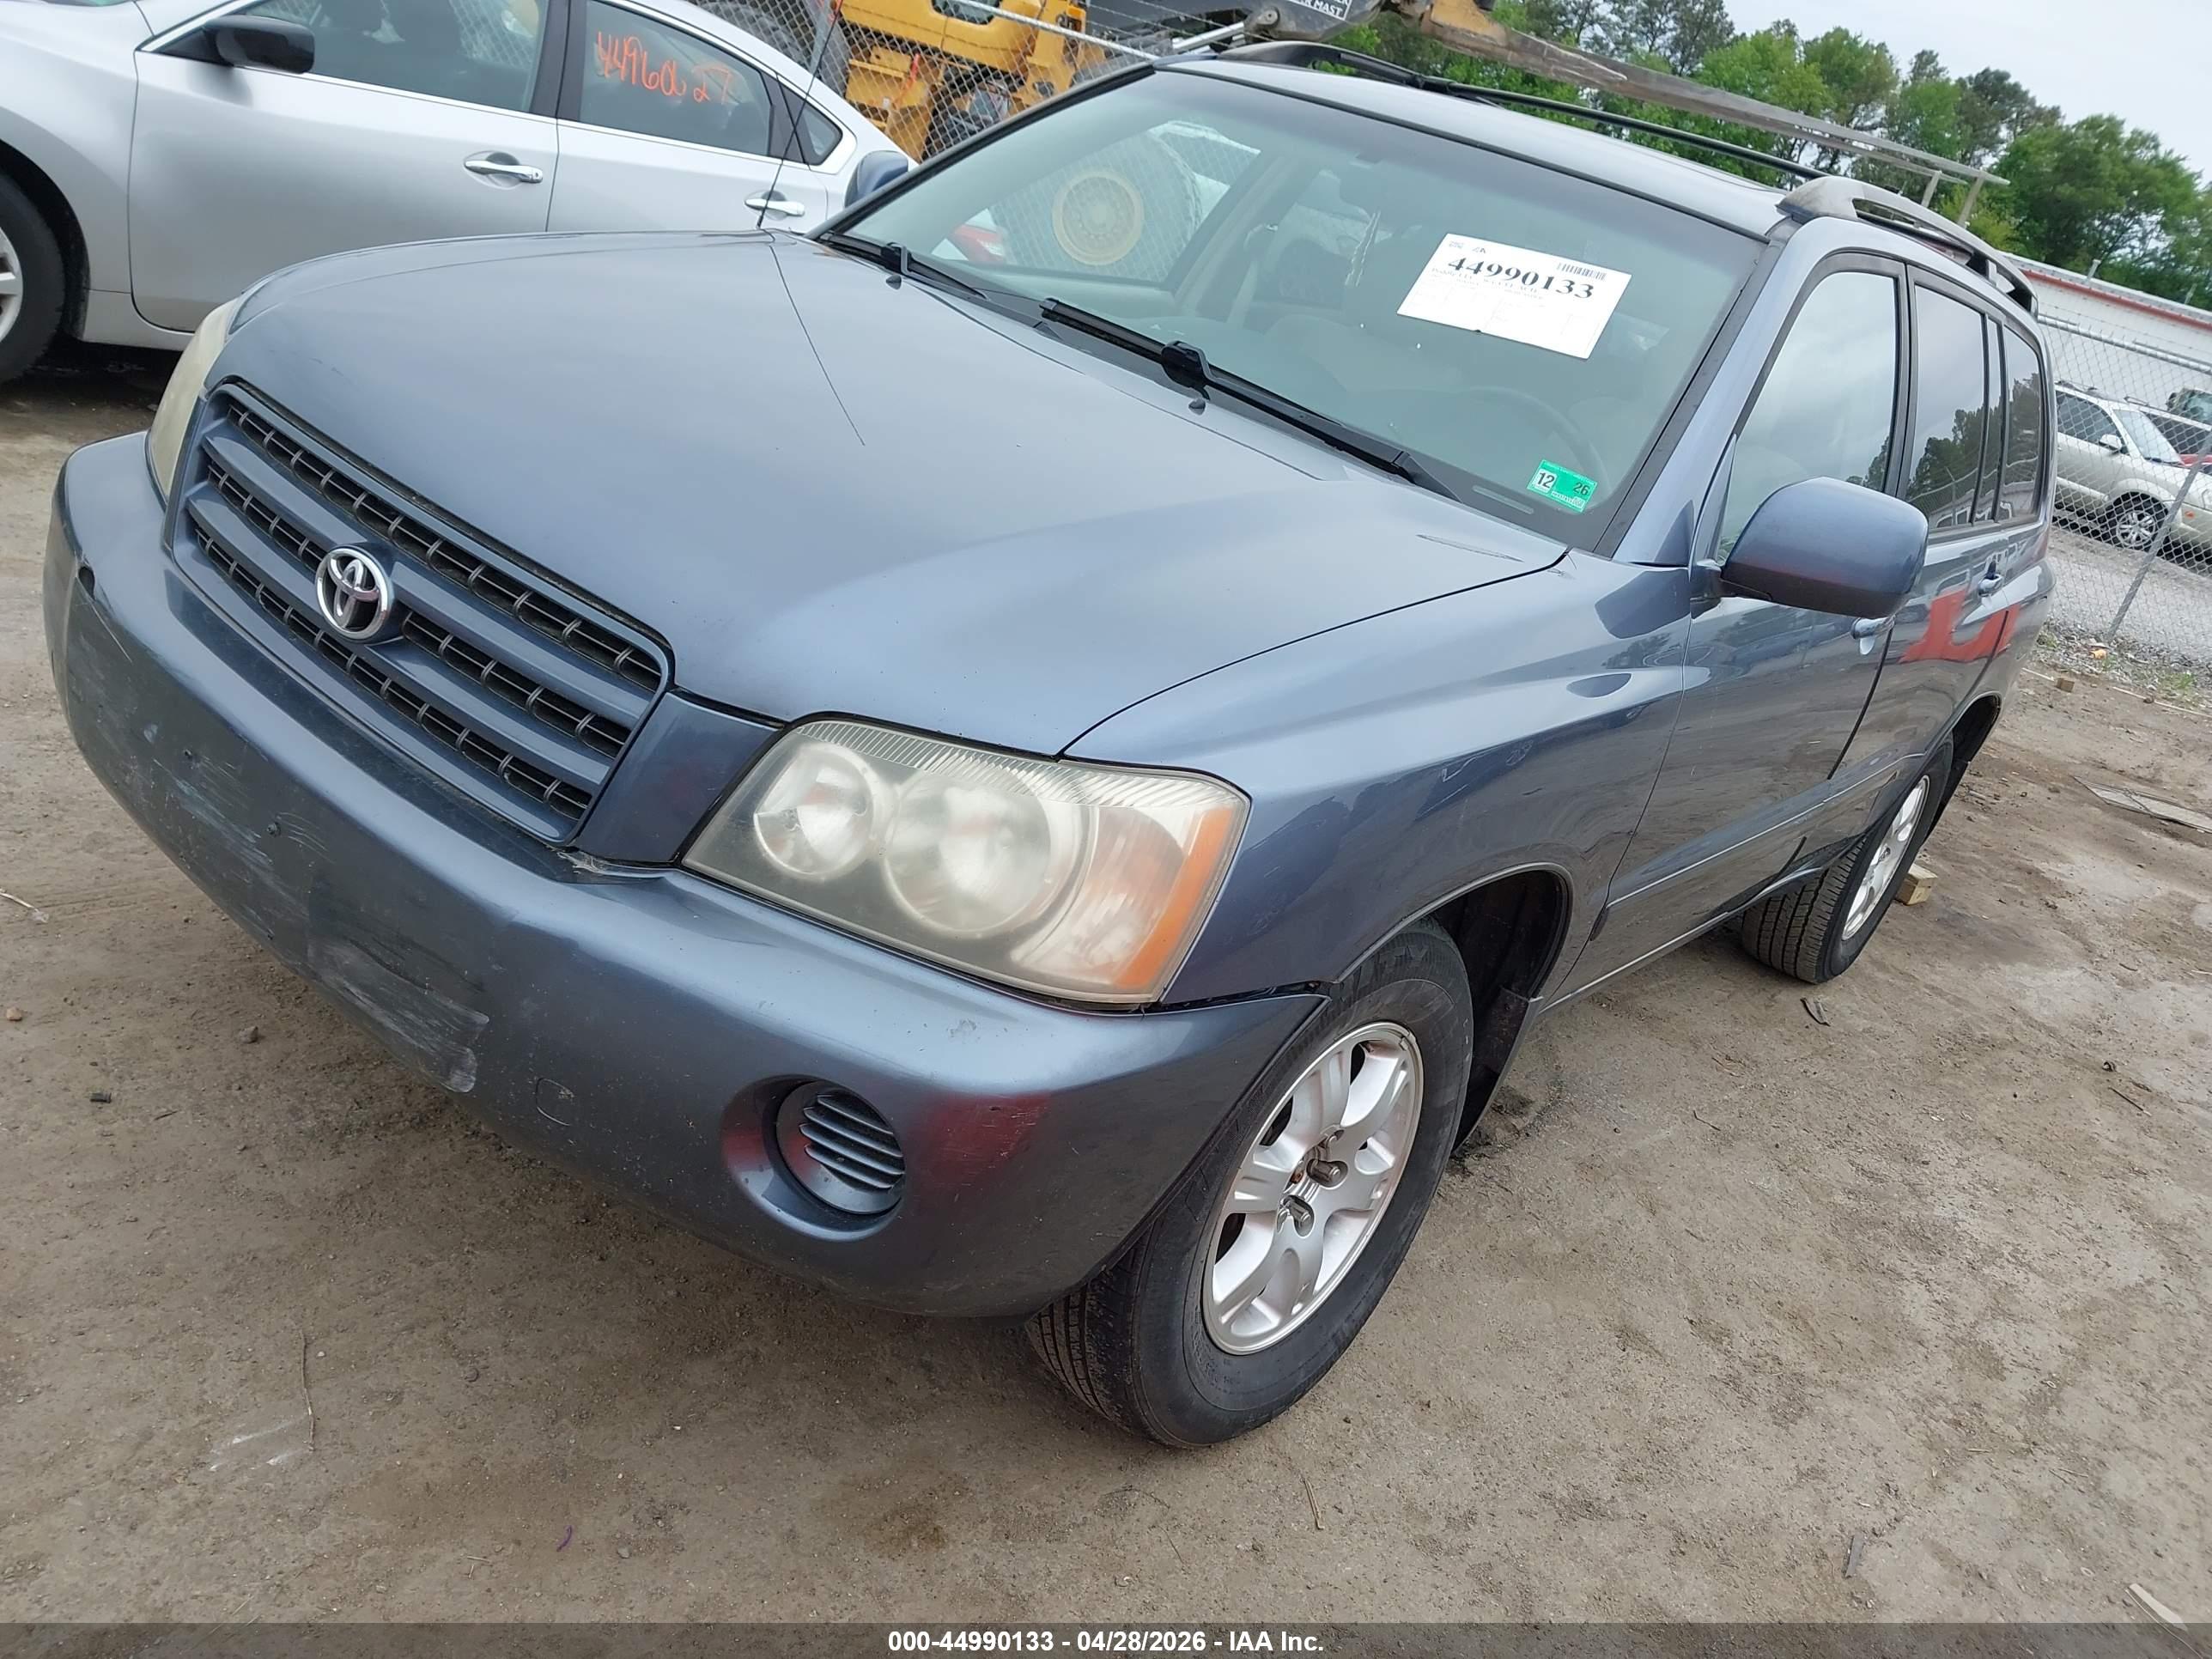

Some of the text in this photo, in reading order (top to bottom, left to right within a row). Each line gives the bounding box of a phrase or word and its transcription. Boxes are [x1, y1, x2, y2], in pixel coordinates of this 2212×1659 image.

[1314, 0, 1343, 16] MAST
[1448, 257, 1595, 299] 44990133
[1537, 472, 1591, 496] 12 26
